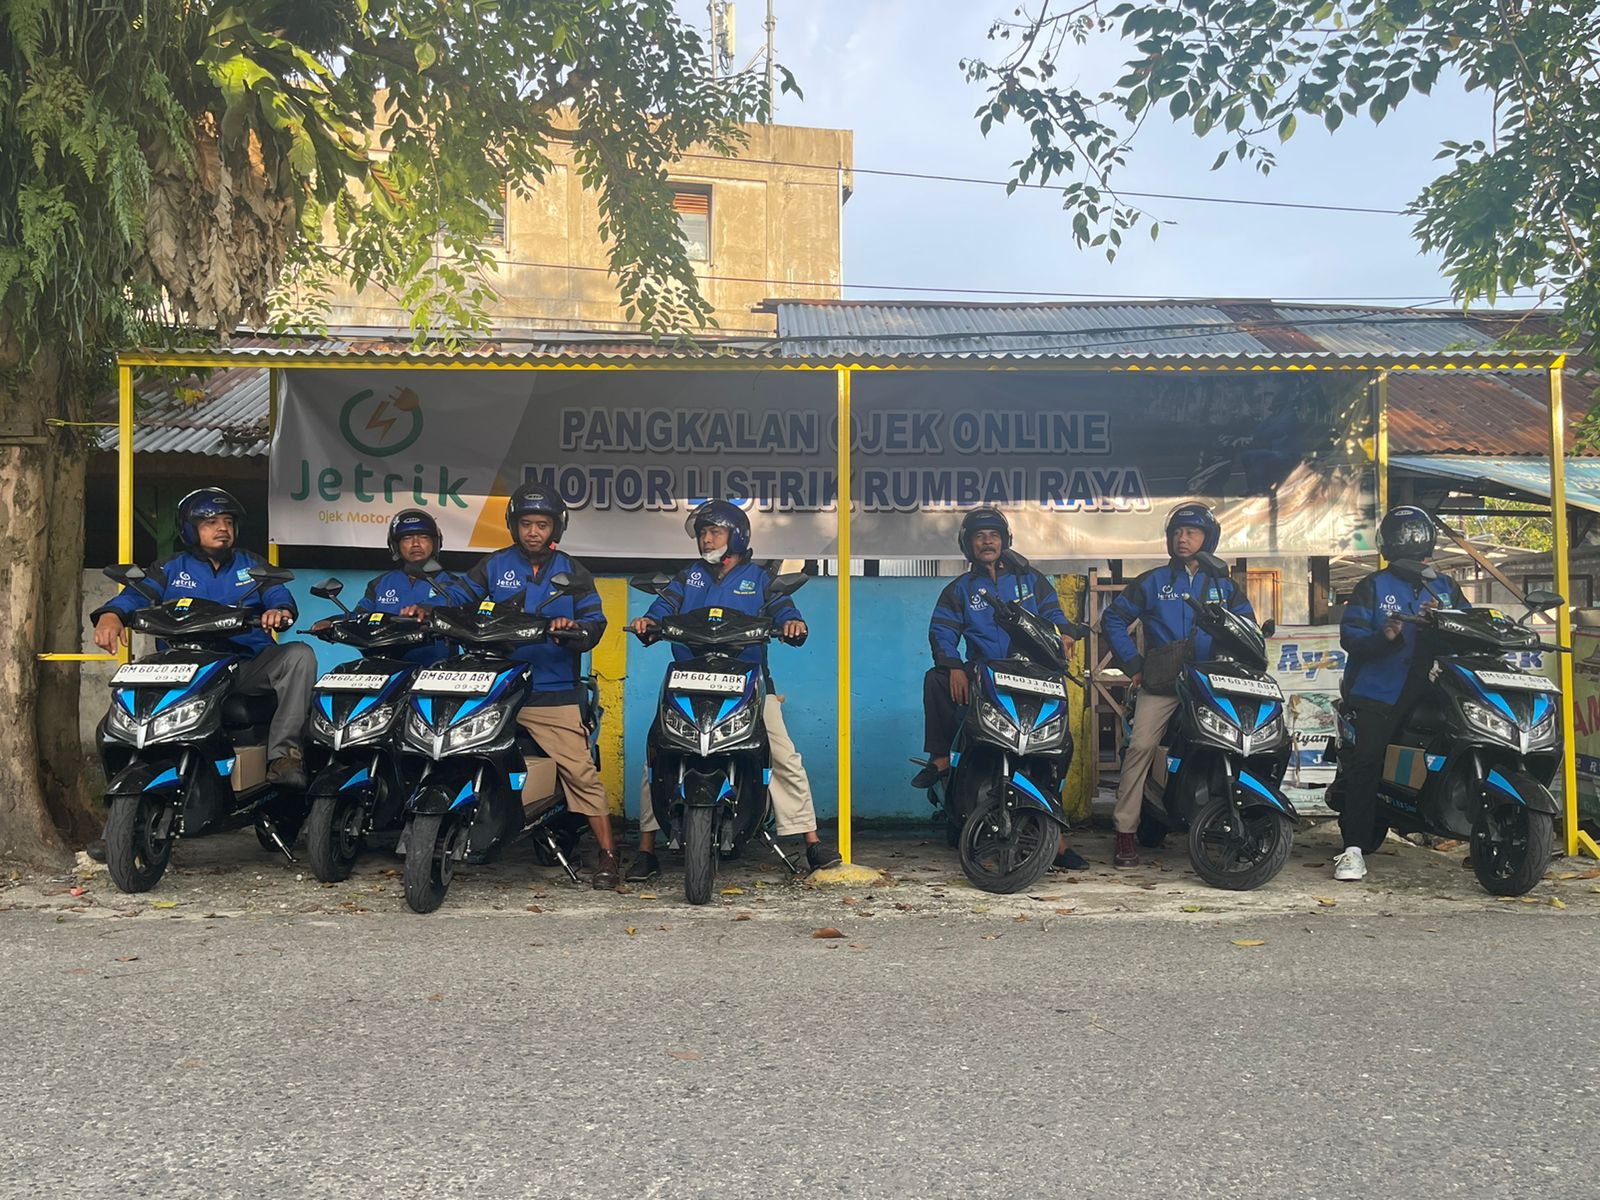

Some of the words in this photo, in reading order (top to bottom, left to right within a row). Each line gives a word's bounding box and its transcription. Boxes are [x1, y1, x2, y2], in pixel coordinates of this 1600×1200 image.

[561, 408, 817, 452] PANGKALAN
[829, 409, 940, 452] OJEK
[951, 410, 1109, 452] ONLINE
[290, 459, 469, 508] Jetrik
[863, 469, 1025, 509] RUMBAI
[1038, 469, 1149, 509] RAYA
[346, 511, 391, 524] Motor
[171, 580, 197, 588] Jetrik
[120, 665, 138, 674] BM
[171, 665, 193, 673] ABK
[420, 671, 438, 681] BM
[437, 672, 467, 681] 6020
[470, 673, 493, 682] ABK
[673, 672, 689, 680] BM
[722, 675, 743, 684] ABK
[709, 683, 741, 691] 09-27
